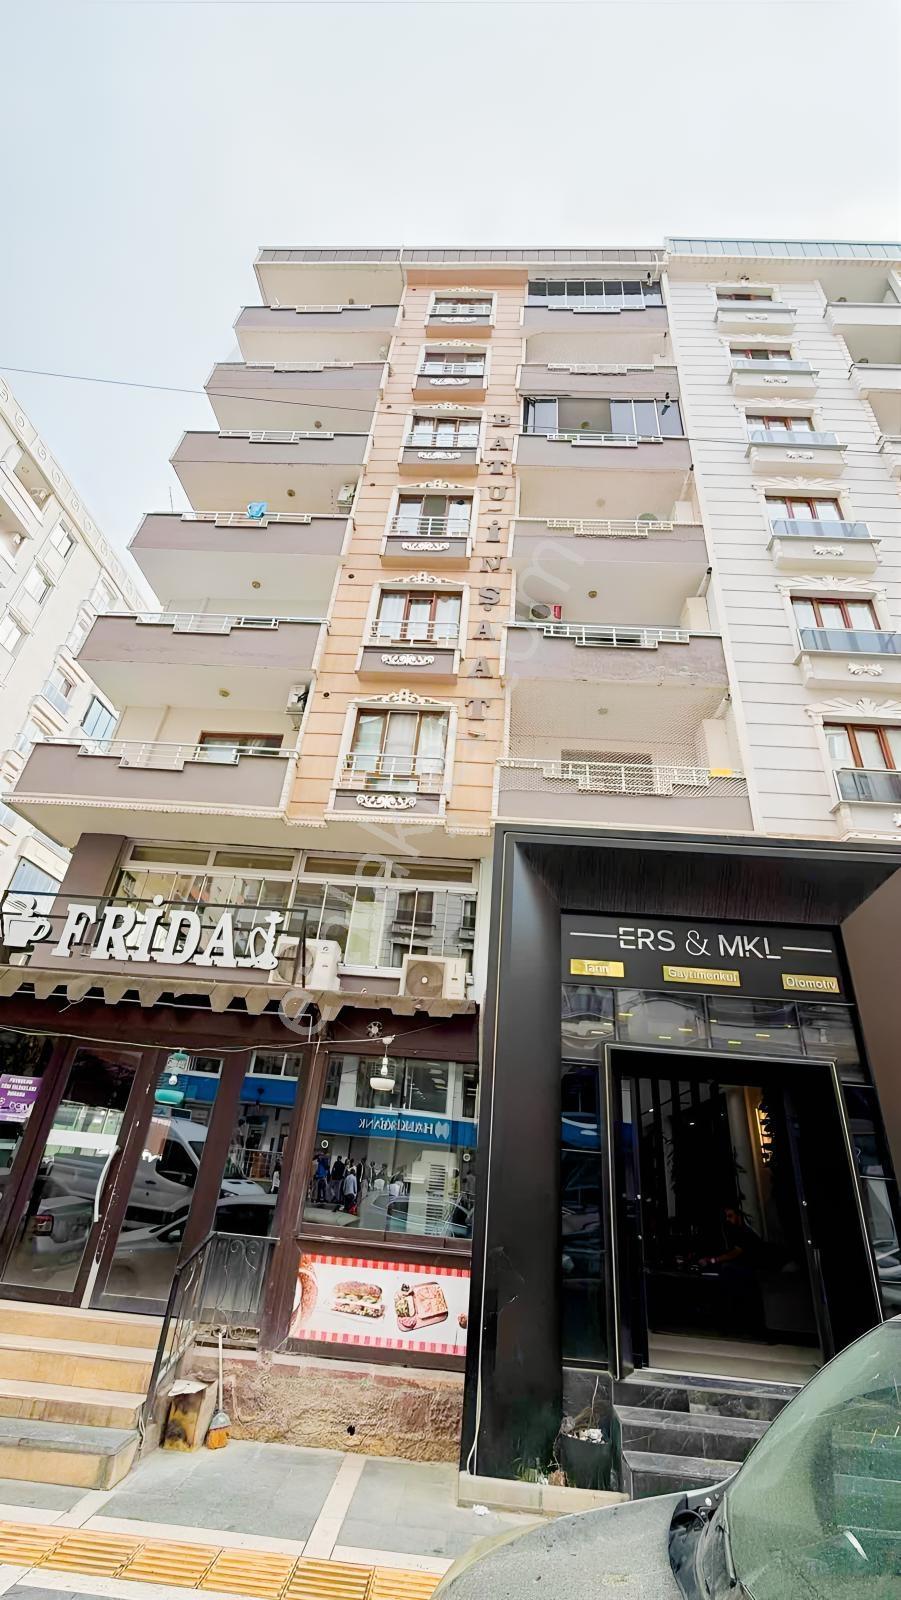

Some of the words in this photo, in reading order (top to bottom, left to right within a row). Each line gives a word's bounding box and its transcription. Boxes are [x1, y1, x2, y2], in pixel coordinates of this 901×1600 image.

[617, 926, 676, 952] ERS
[685, 930, 712, 956] &
[717, 934, 782, 960] MKL
